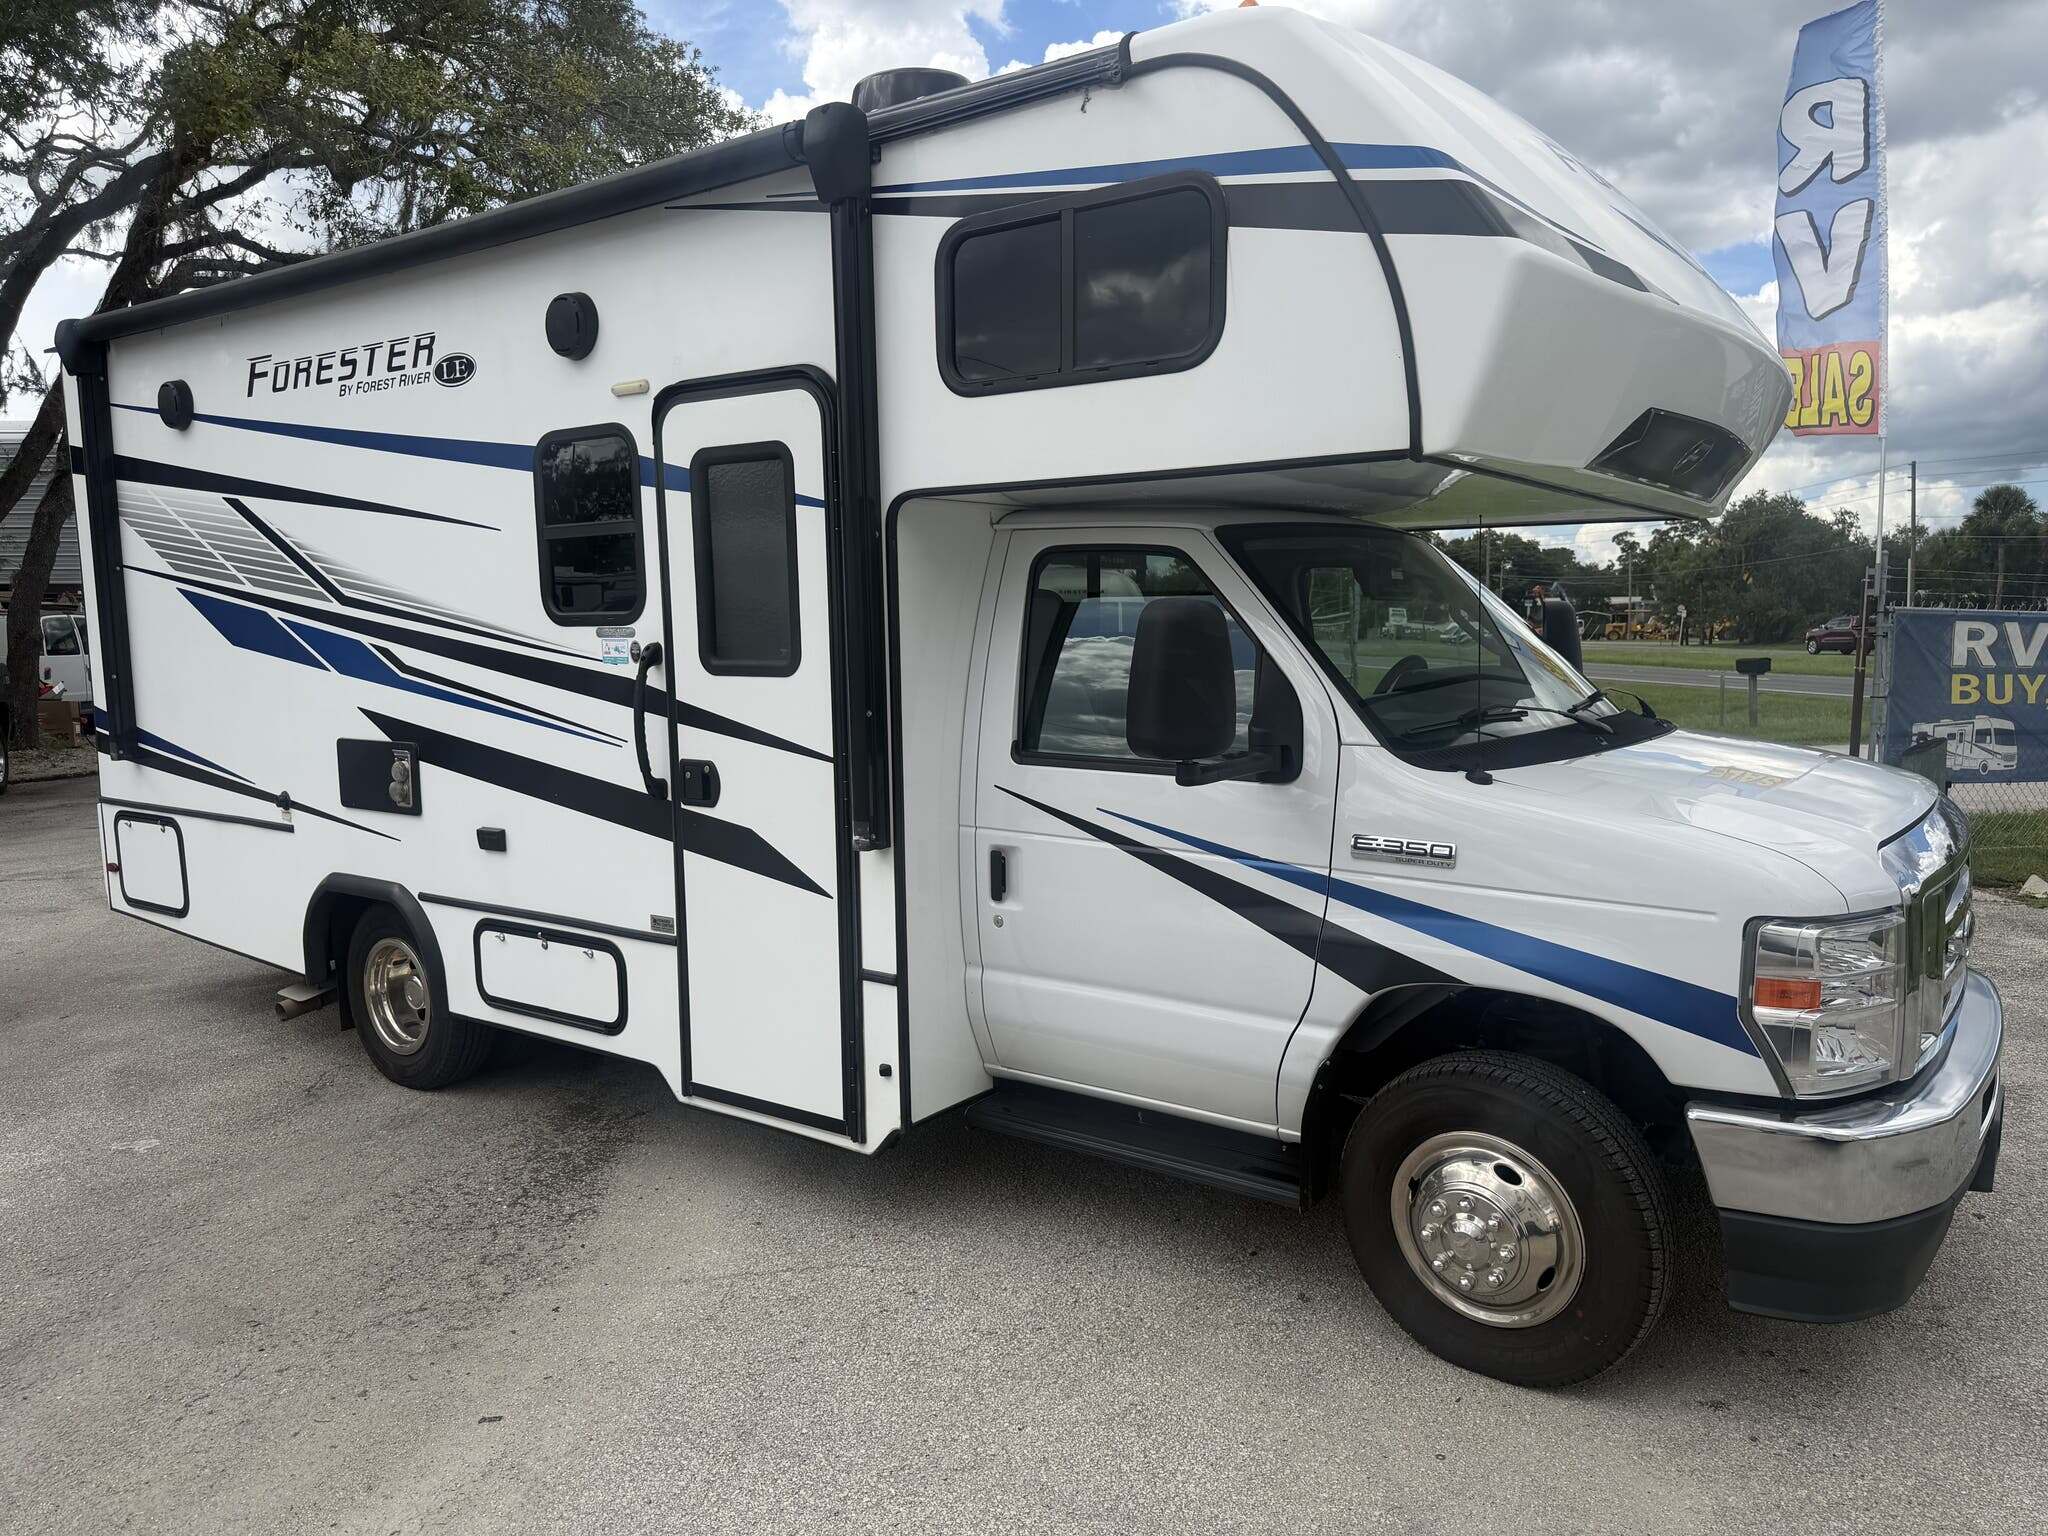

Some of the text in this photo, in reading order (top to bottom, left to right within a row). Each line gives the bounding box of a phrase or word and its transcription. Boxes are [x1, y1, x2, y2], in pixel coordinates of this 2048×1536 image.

[246, 331, 437, 398] FORESTER
[440, 360, 468, 382] LE
[339, 372, 432, 398] BY FOREST RIVER
[1353, 836, 1454, 860] E-350
[1427, 860, 1452, 868] DUTY
